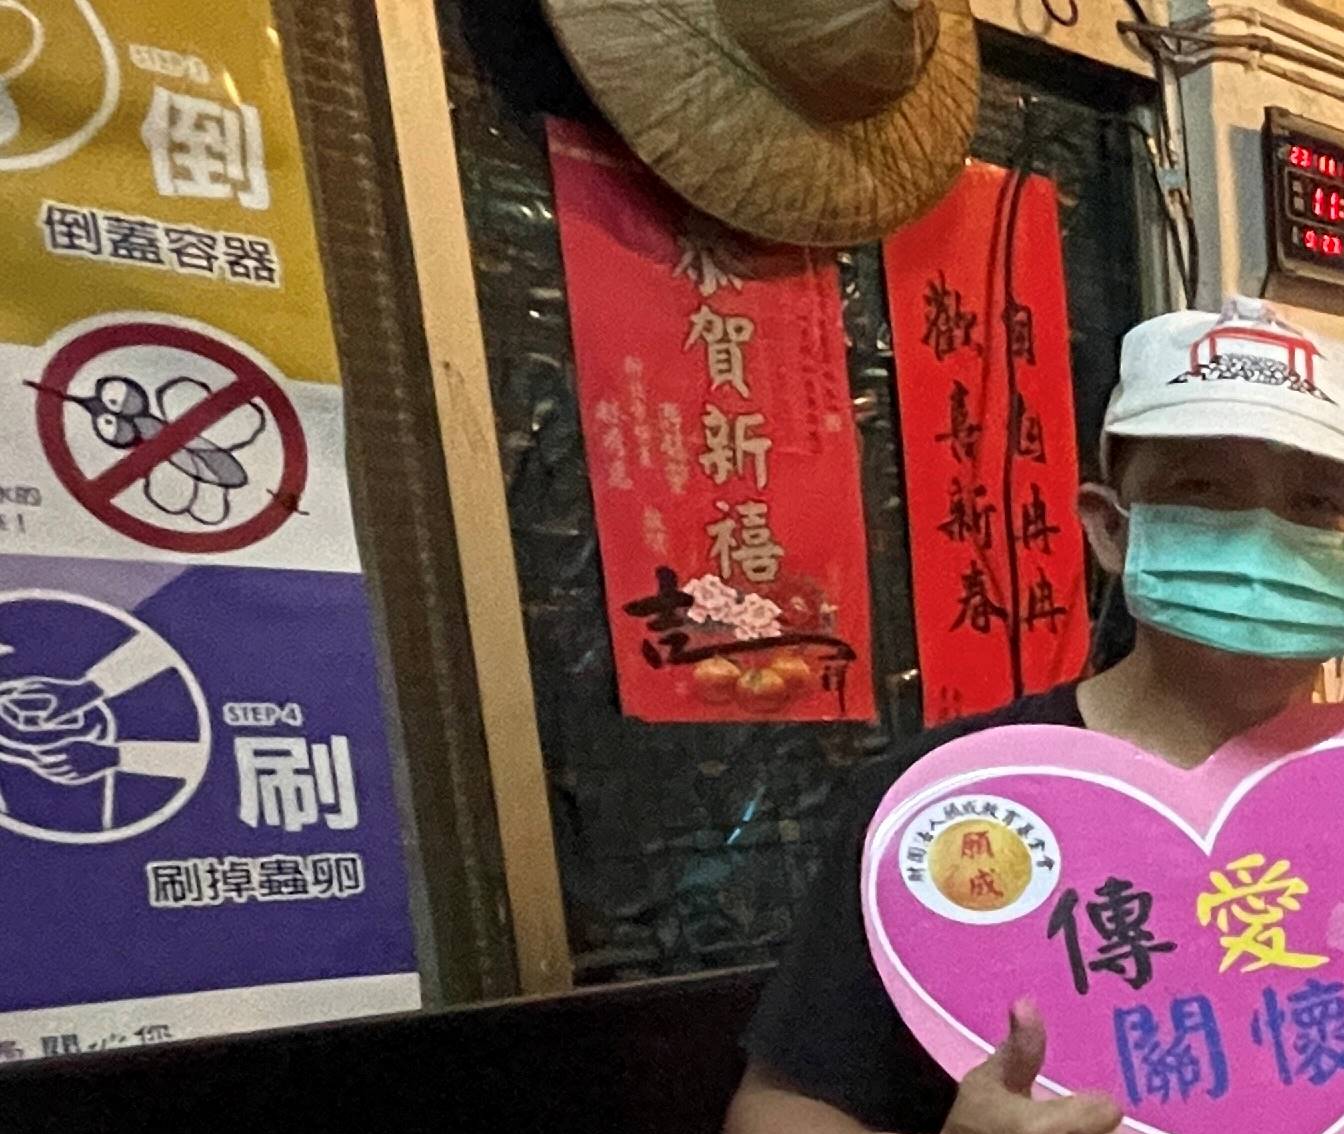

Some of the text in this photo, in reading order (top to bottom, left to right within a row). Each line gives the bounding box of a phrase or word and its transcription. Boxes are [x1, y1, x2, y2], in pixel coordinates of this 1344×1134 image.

[142, 85, 271, 210] 倒
[42, 204, 280, 286] 倒蓋容器
[225, 703, 279, 725] STEP
[234, 734, 359, 832] 刷
[148, 854, 364, 907] 刷掉蟲卵
